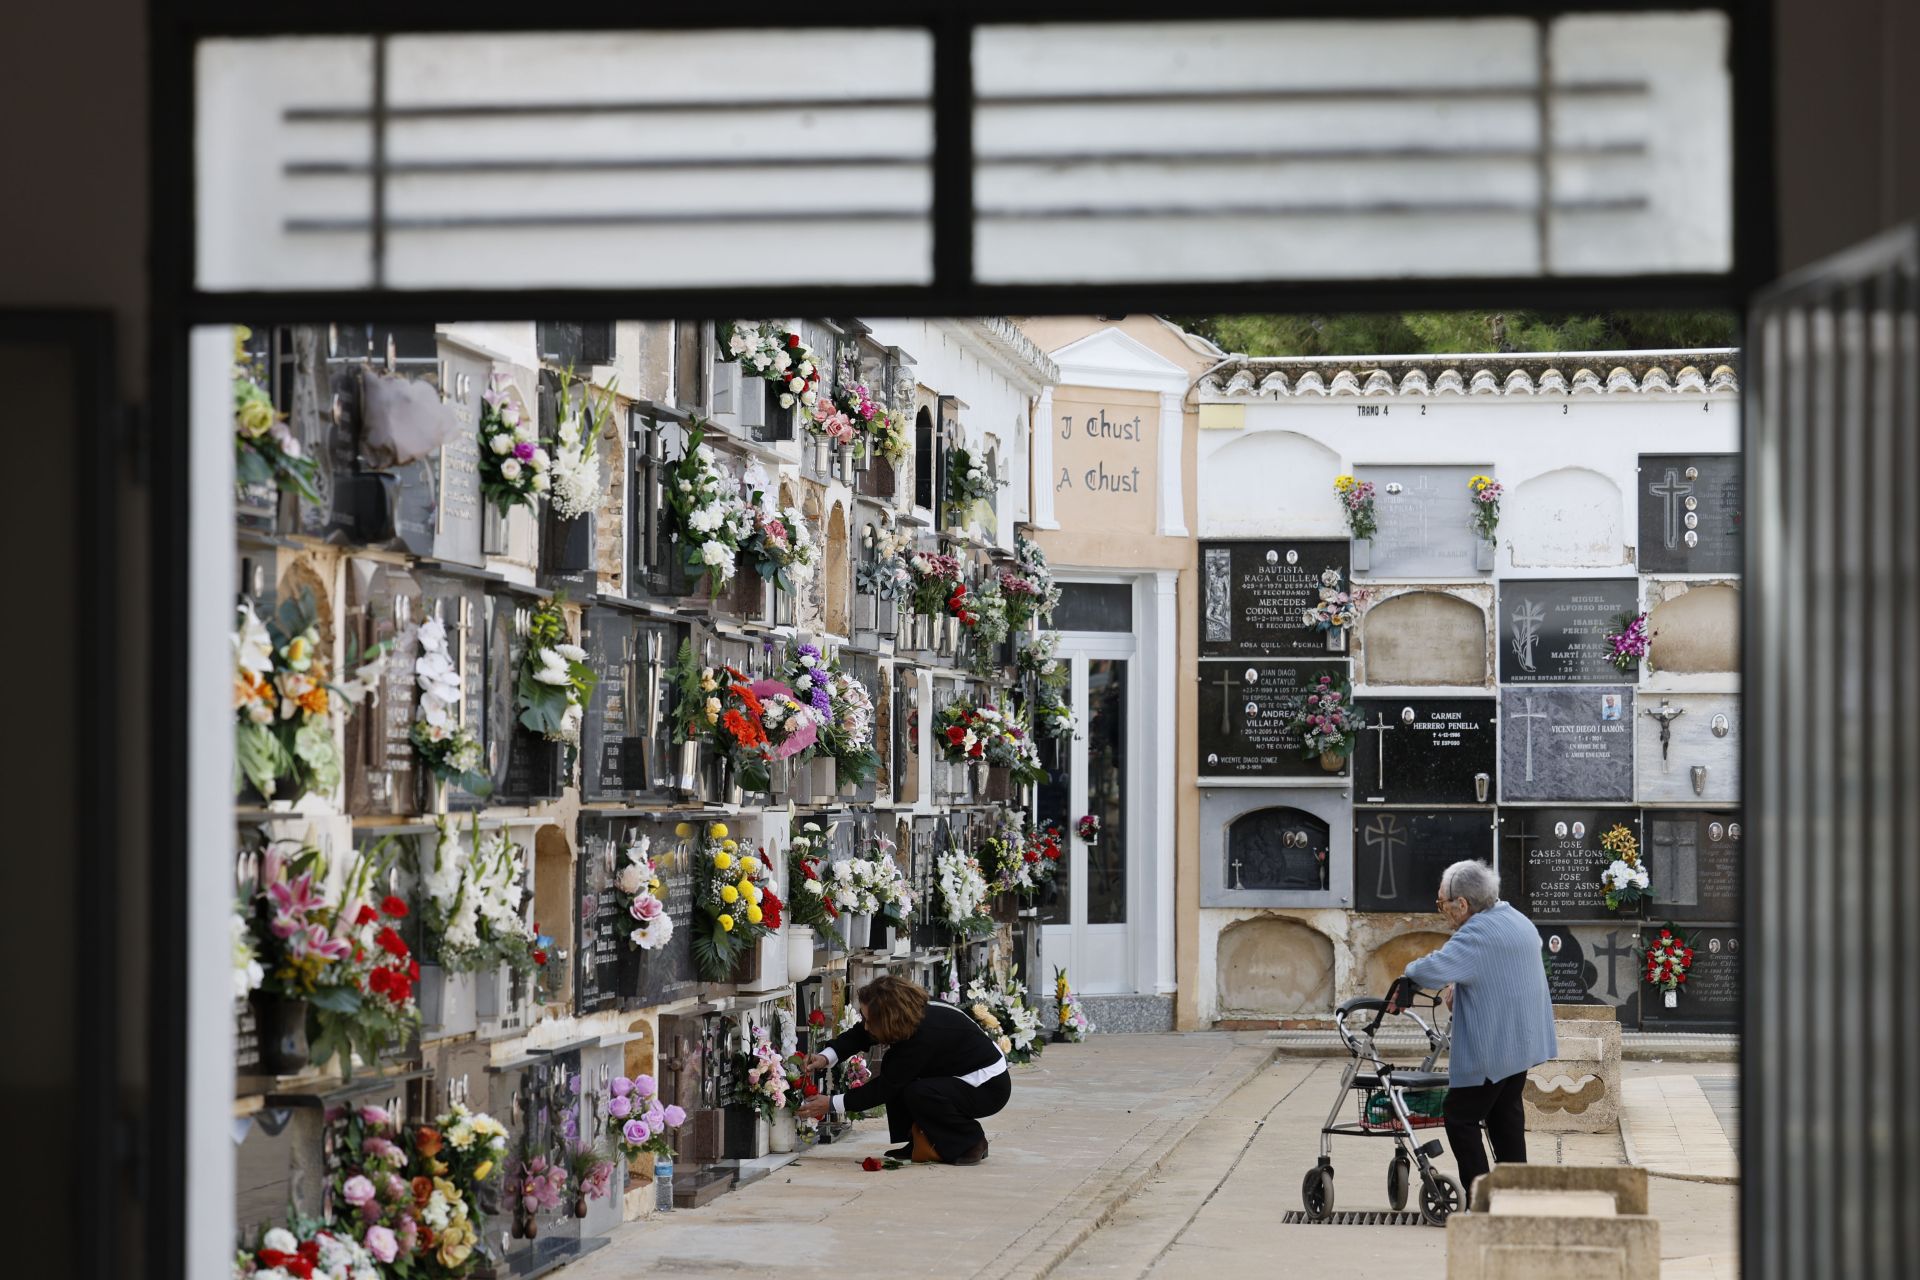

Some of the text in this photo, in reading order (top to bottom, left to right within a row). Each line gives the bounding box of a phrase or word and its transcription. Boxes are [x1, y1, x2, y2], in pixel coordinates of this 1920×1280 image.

[1357, 405, 1389, 417] TRAMO 4
[1421, 404, 1426, 416] 2
[1563, 404, 1568, 415] 3
[1703, 403, 1709, 413] 4
[1061, 408, 1141, 442] J Chust
[1056, 460, 1140, 493] A Chust
[1258, 566, 1304, 574] BAUTISTA
[1244, 574, 1319, 582] RAGA GUILLEM
[1258, 598, 1307, 606] MERCEDES
[1245, 607, 1278, 615] CODINA
[1551, 651, 1579, 659] MARTÍ
[1260, 678, 1296, 686] CALATAYUD
[1261, 710, 1296, 718] ANDREA
[1431, 712, 1462, 720] CARMEN
[1246, 719, 1285, 727] VILLALBA
[1413, 722, 1480, 730] HERRERO PENELLA
[1551, 725, 1575, 733] VICENT
[1576, 725, 1596, 733] DIEGO
[1601, 723, 1625, 733] RAMÓN
[1220, 756, 1241, 764] VICENTE
[1559, 840, 1582, 849] JOSE
[1530, 849, 1562, 858] CASES
[1559, 873, 1582, 881] JOSE
[1540, 882, 1600, 890] CASES ASINS
